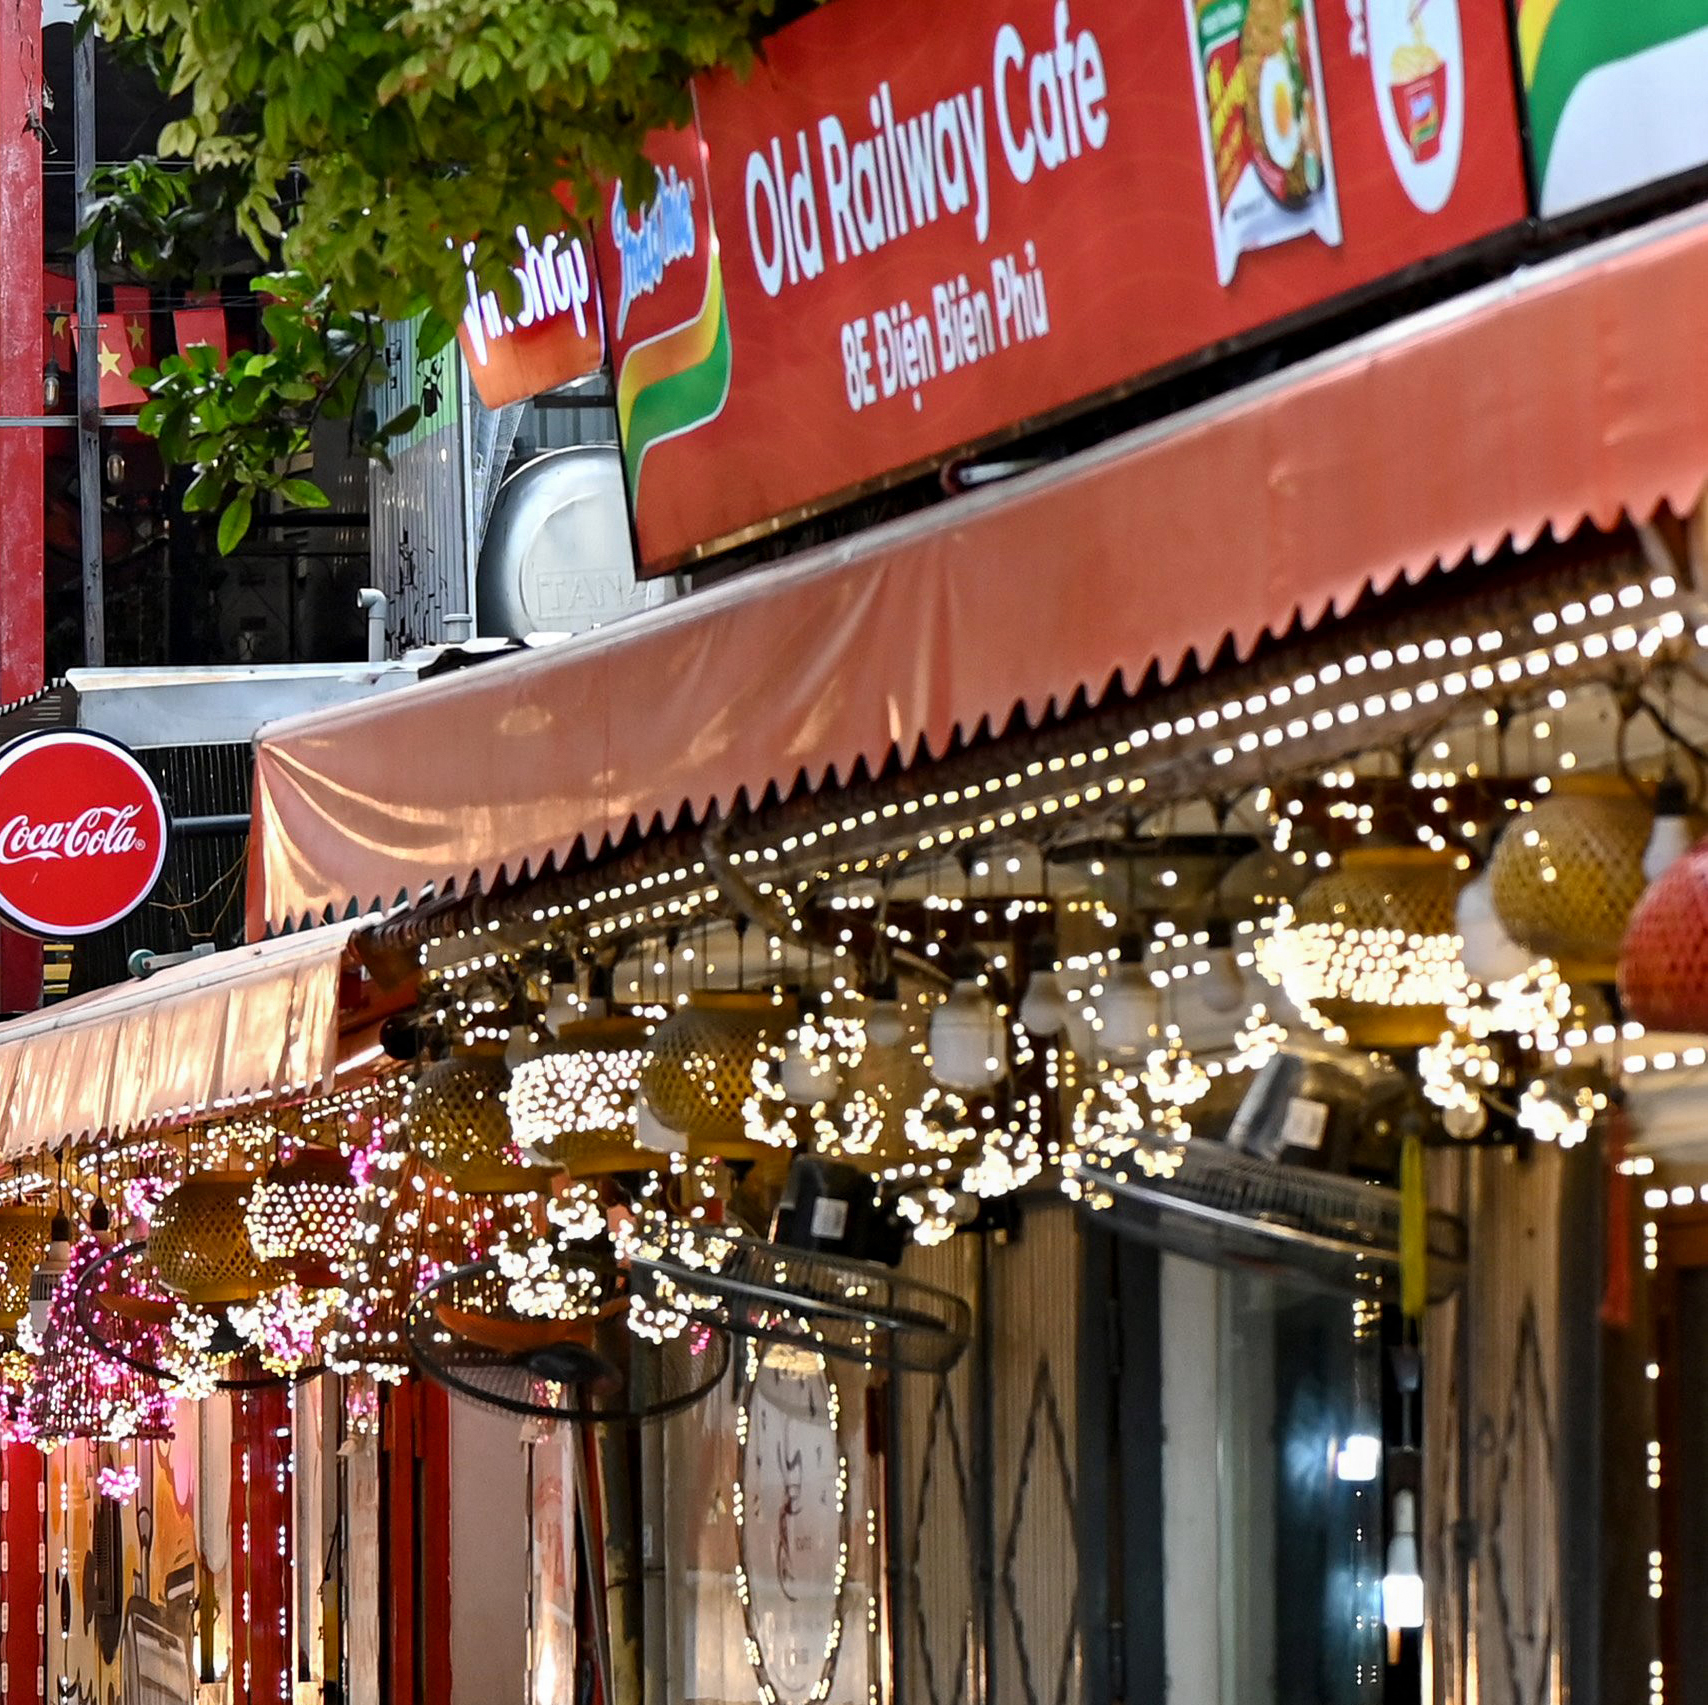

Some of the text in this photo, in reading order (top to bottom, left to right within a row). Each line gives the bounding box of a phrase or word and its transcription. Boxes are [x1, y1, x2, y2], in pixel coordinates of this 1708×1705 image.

[745, 130, 825, 297] Old
[818, 80, 990, 264] Railway
[993, 0, 1109, 184] Cafe
[841, 240, 1051, 412] 8E Điện Biên Phủ
